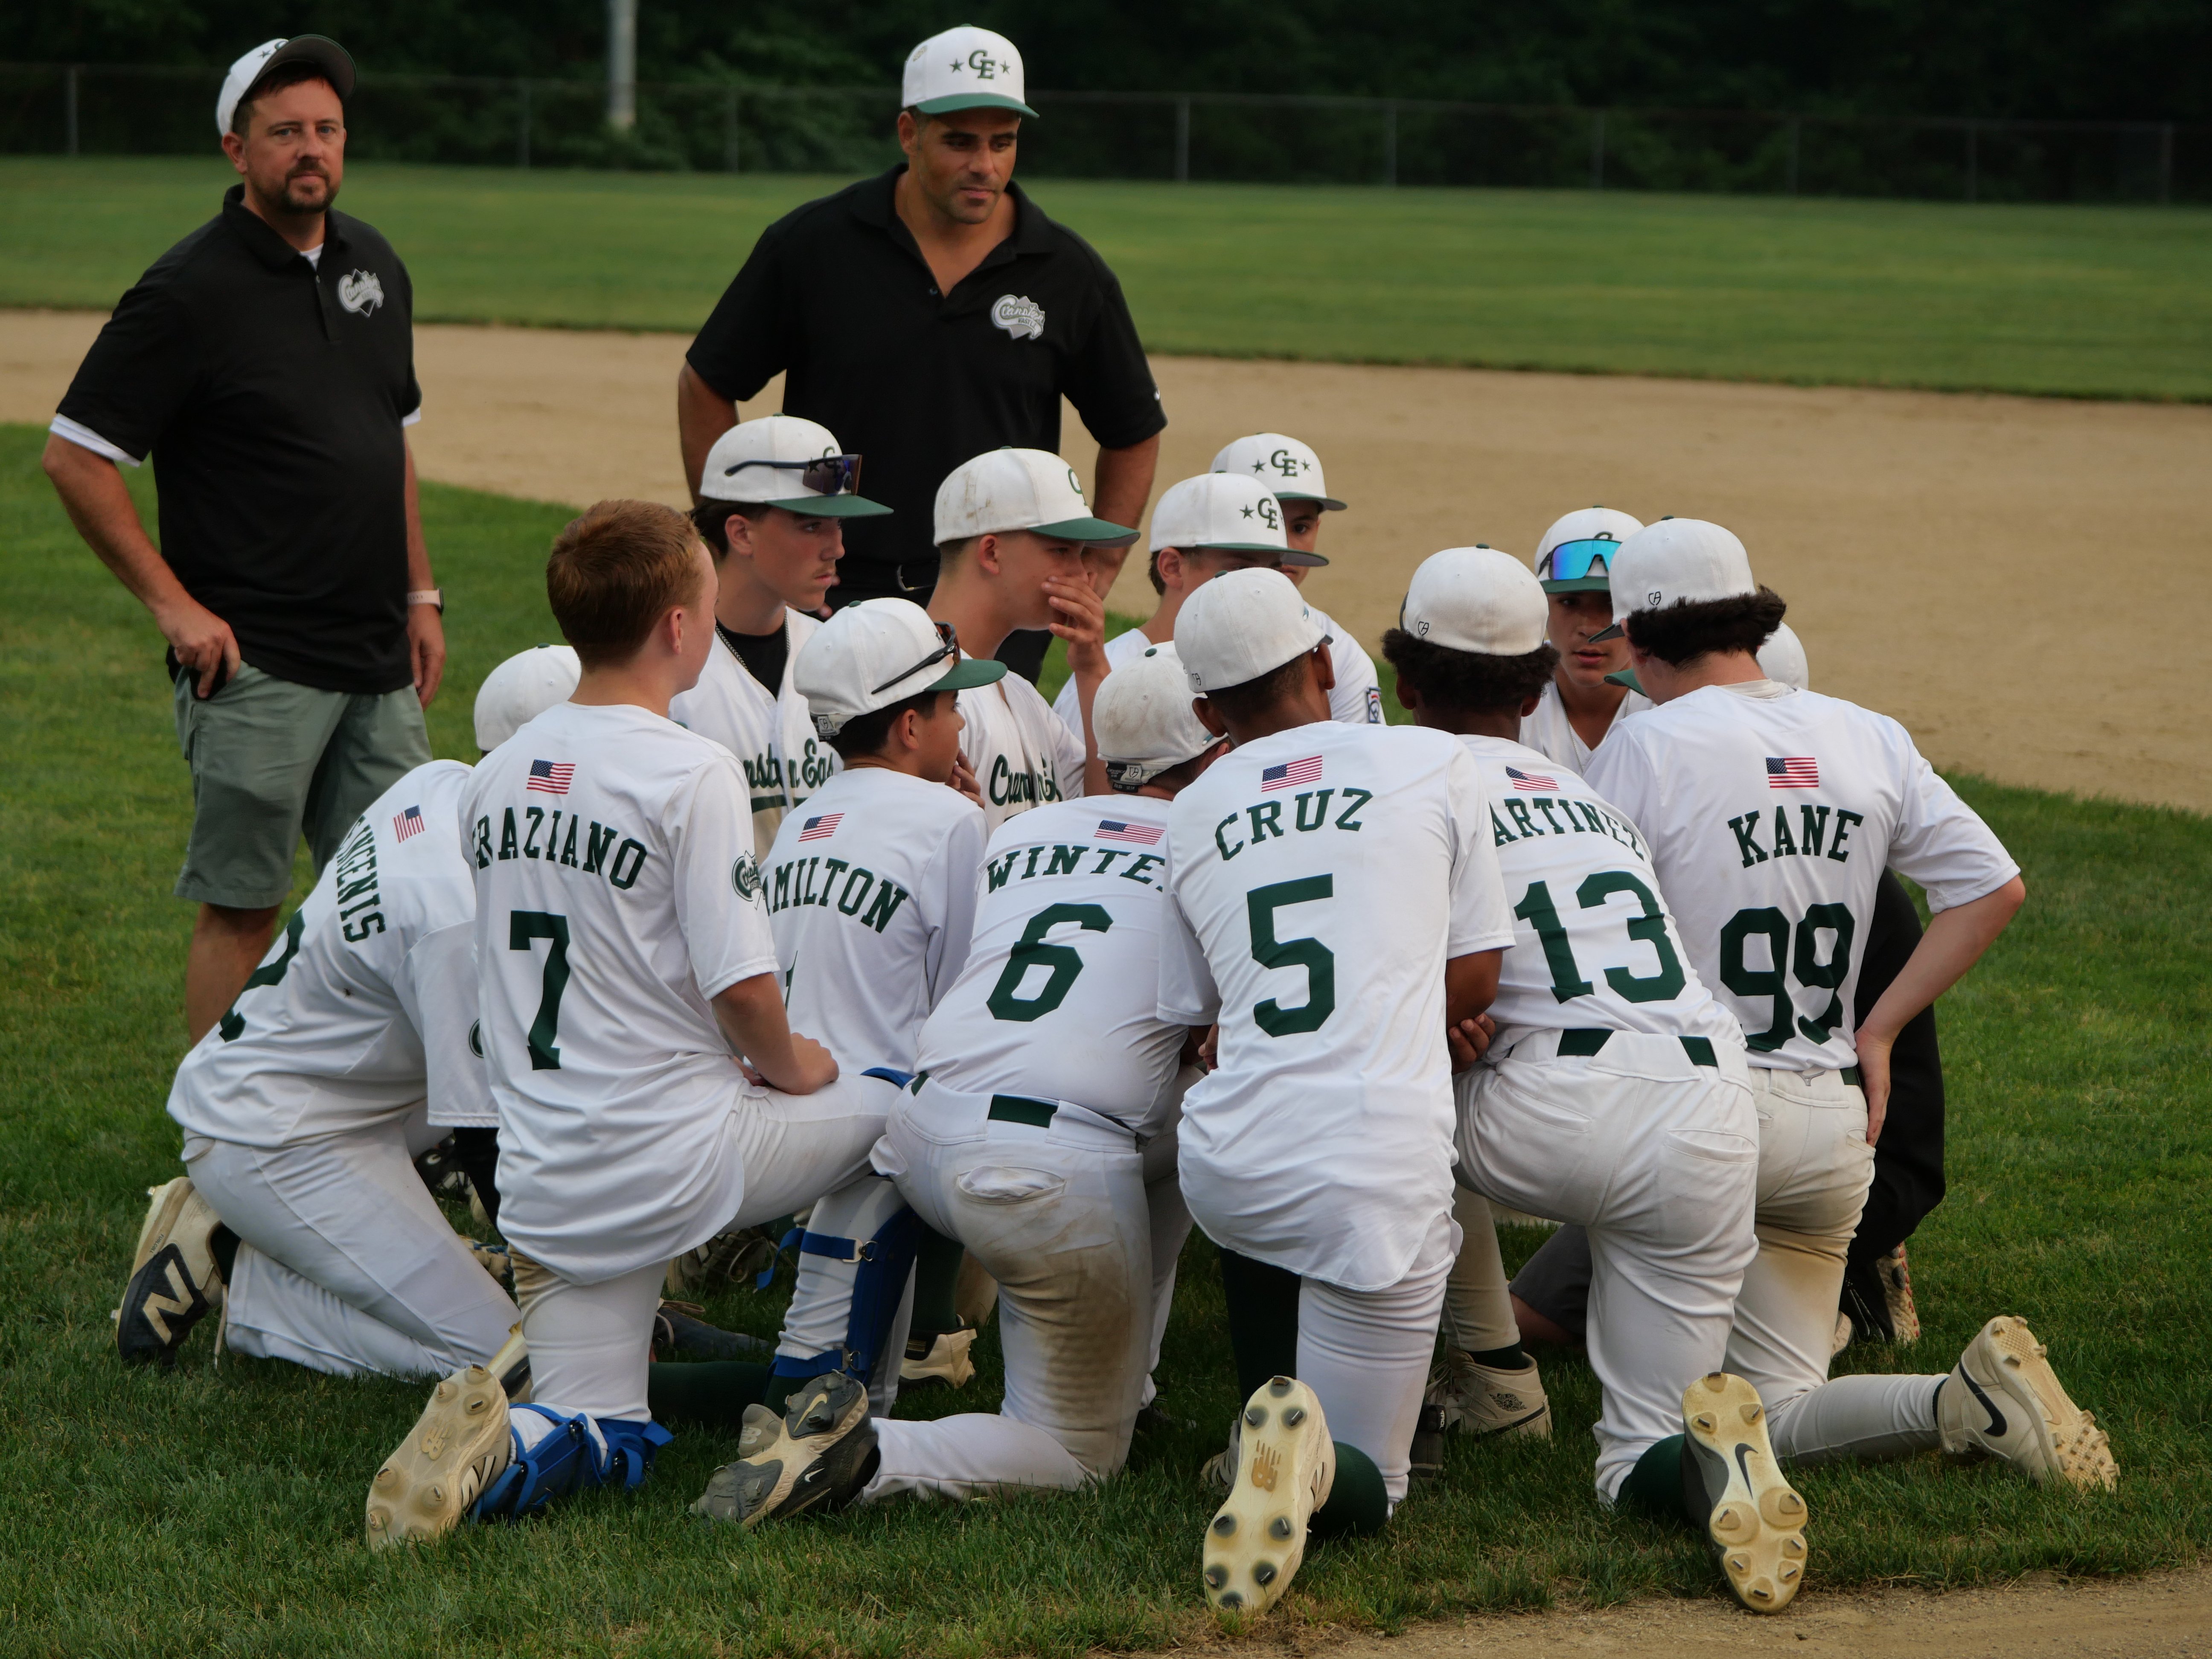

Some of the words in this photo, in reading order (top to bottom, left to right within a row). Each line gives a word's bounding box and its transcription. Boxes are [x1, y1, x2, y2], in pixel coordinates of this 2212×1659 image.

[969, 49, 996, 79] CE
[1271, 449, 1298, 477] CE
[1257, 497, 1279, 530] CE
[1215, 787, 1374, 861] CRUZ
[1727, 804, 1864, 868] KANE
[987, 844, 1166, 894] WINTE
[986, 902, 1114, 1022] 6
[1246, 873, 1336, 1038] 5
[1513, 870, 1687, 1005] 13
[509, 910, 570, 1071] 7
[1720, 902, 1855, 1052] 99
